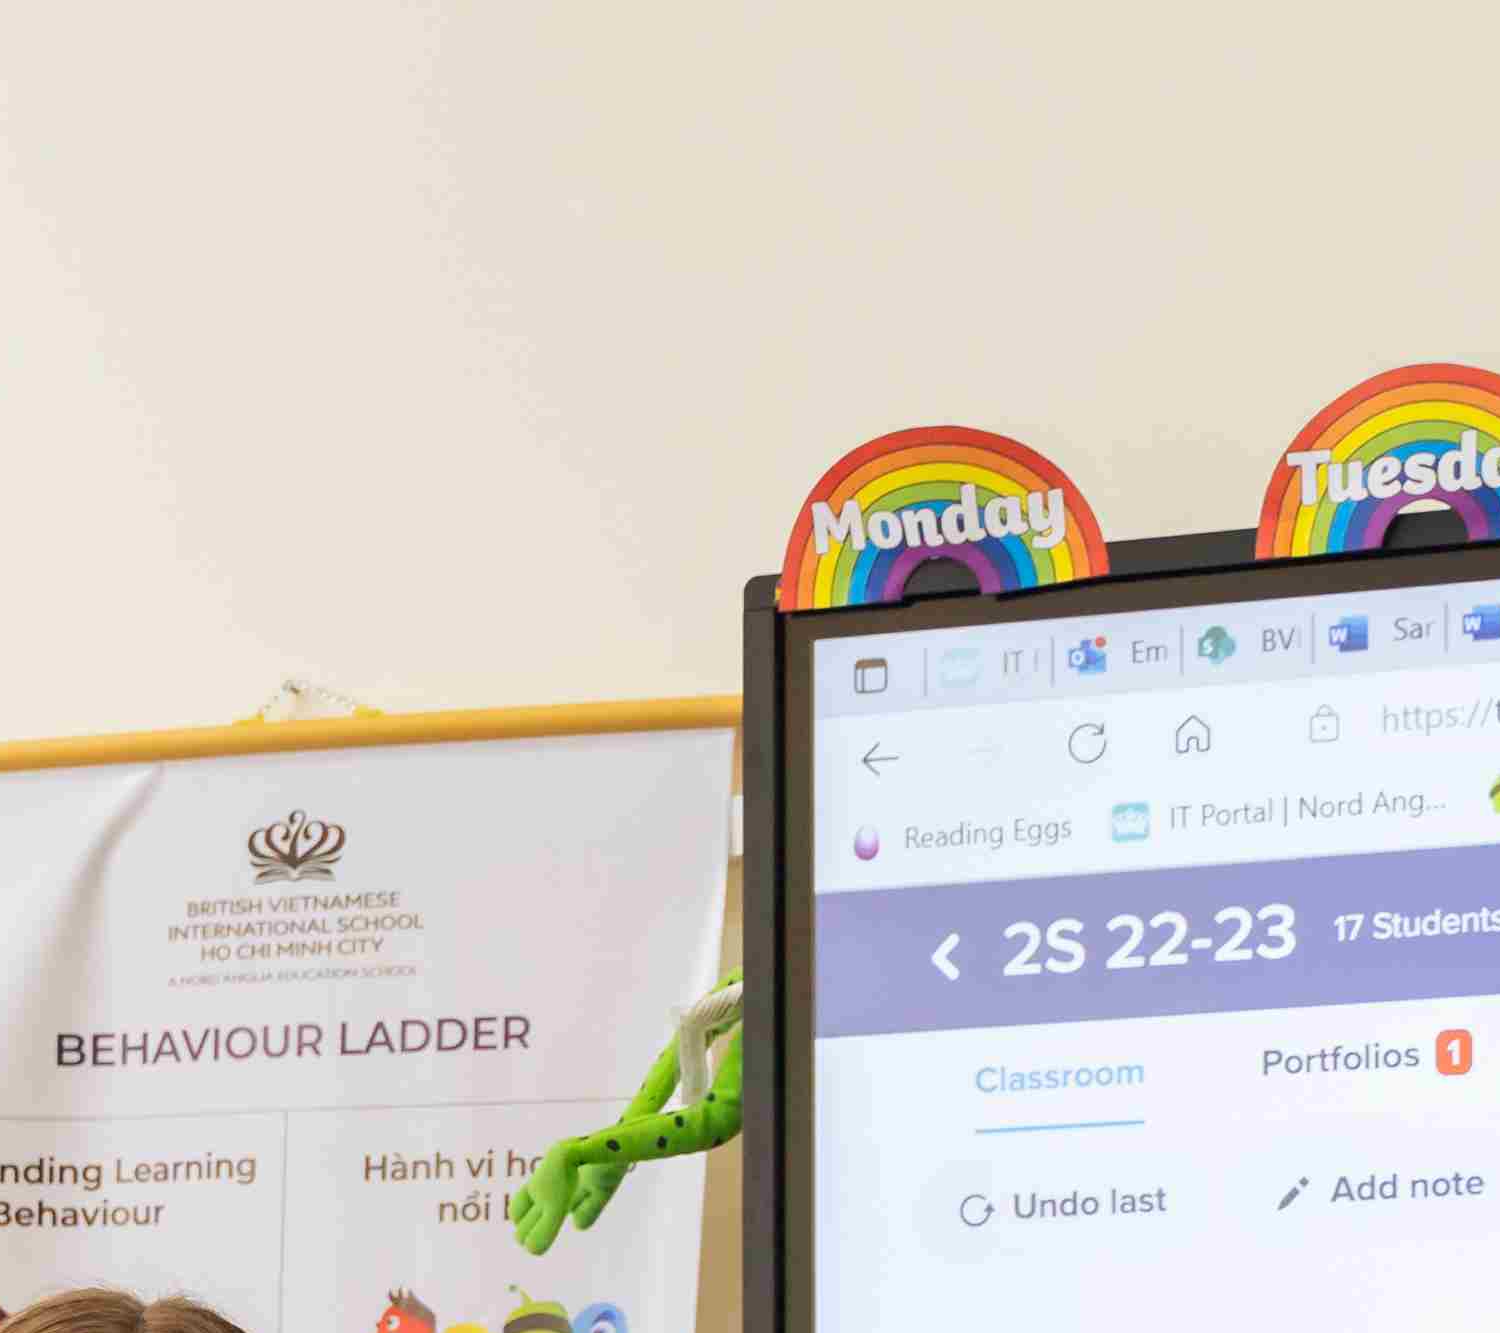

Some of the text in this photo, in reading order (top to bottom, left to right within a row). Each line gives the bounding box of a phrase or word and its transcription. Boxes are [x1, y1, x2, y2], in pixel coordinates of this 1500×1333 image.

[810, 482, 1069, 555] Monday
[1171, 805, 1192, 831] IT
[1202, 798, 1275, 829] Portal
[1299, 792, 1365, 824] Nord
[905, 817, 1073, 852] Reading Eggs
[185, 890, 401, 919] BRITISH VIETNAMESE
[168, 912, 425, 942] INTERNATIONAL SCHOOL
[1002, 903, 1297, 977] 2S 22-23
[1333, 914, 1364, 942] 17
[200, 935, 385, 962] HO CHI MINH CITY
[56, 1014, 532, 1068] BEHAVIOUR LADDER
[1262, 1041, 1421, 1076] Portfolios
[975, 1060, 1146, 1095] Classroom
[115, 1152, 257, 1185] Learning
[363, 1149, 494, 1182] Hành vi
[1012, 1186, 1168, 1221] Undo last
[1330, 1170, 1485, 1204] Add note
